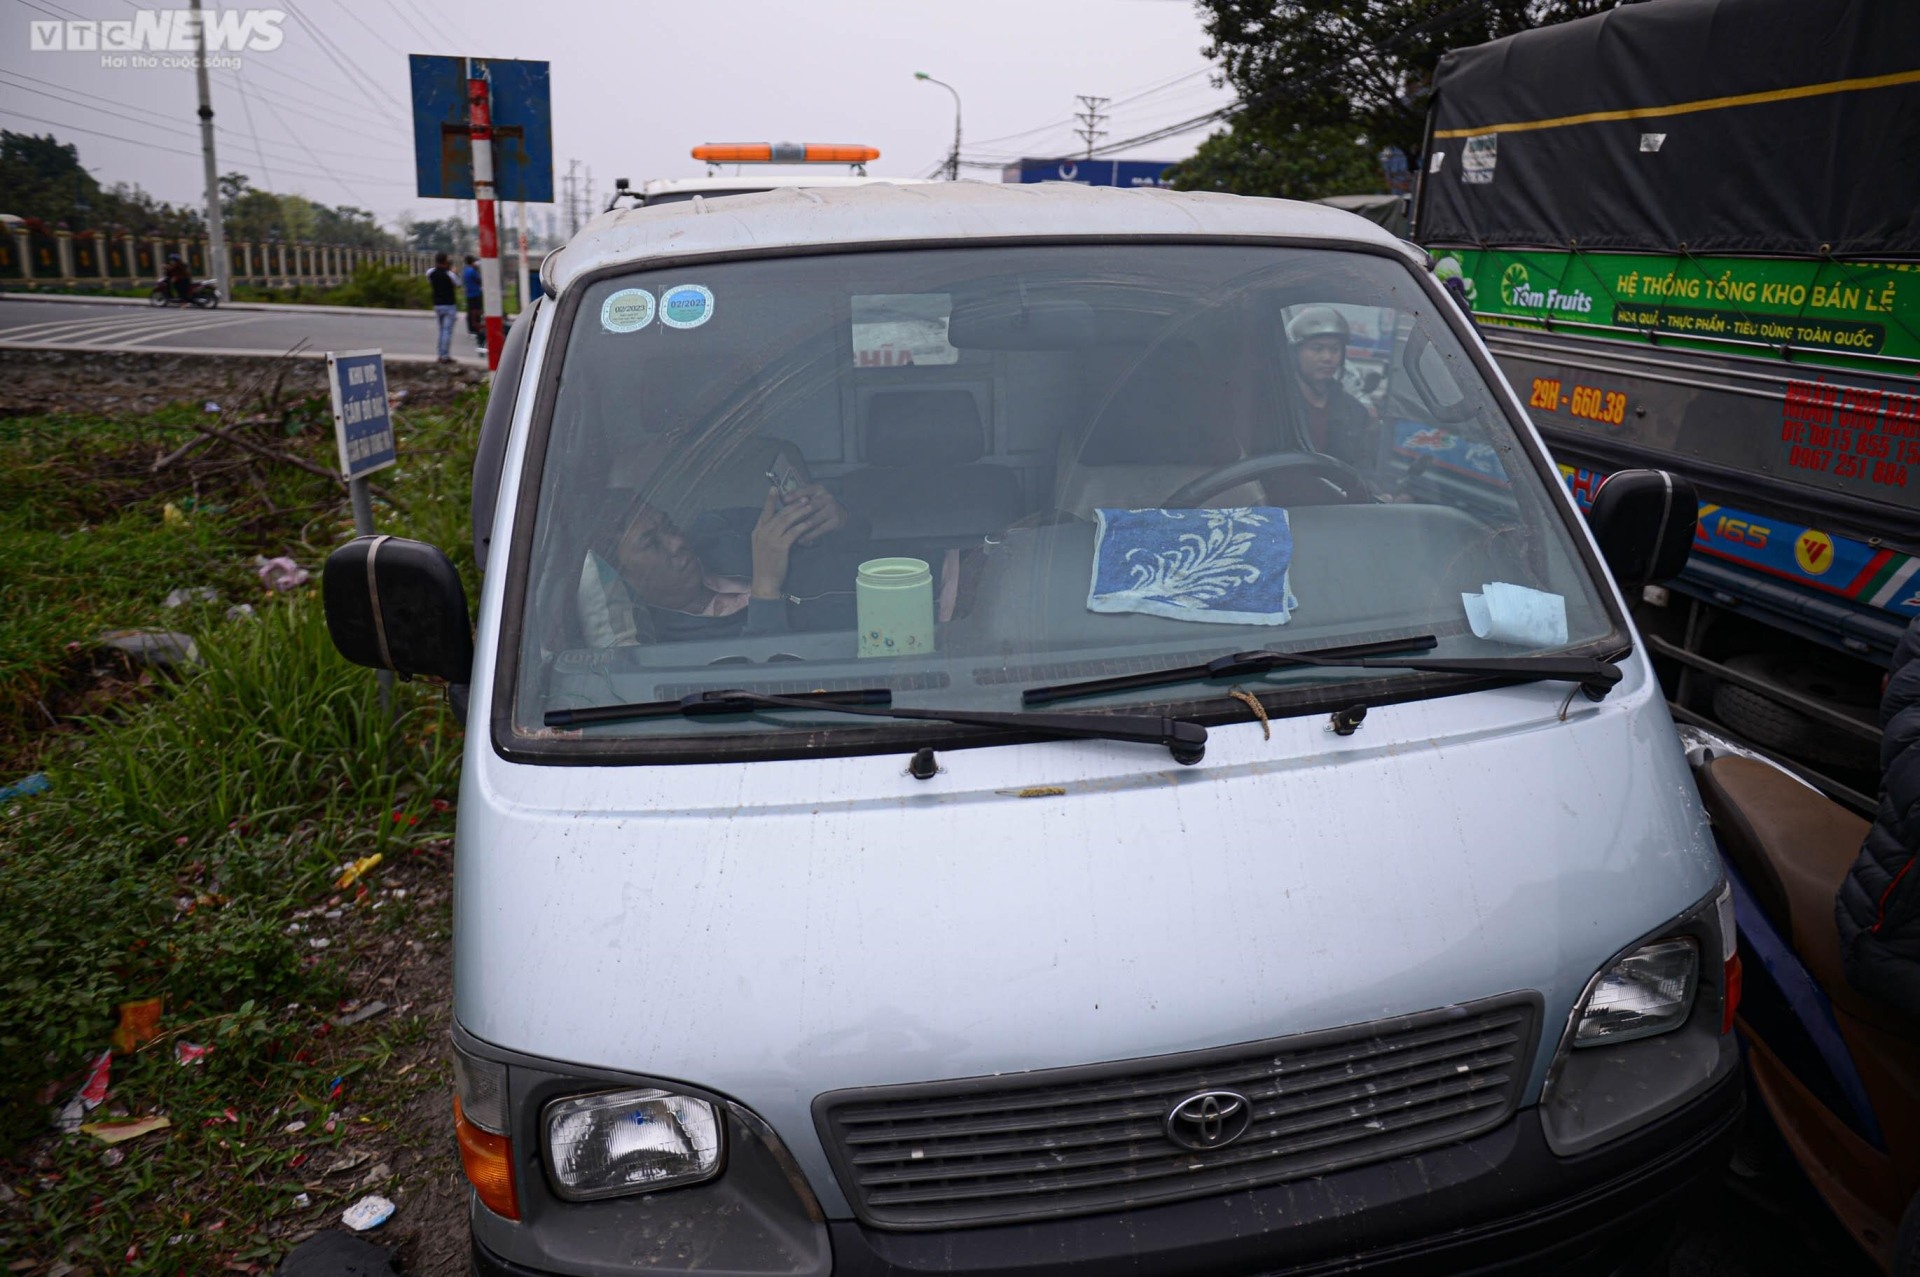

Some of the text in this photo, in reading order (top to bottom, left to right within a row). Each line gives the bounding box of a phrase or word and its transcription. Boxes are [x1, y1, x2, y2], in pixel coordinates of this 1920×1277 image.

[670, 299, 706, 309] 02/2023
[1546, 289, 1593, 313] Fruits
[1616, 270, 1896, 312] HỆ THỐNG TỔNG KHO BÁN LẺ
[614, 304, 645, 314] 02/2023
[1667, 315, 1695, 331] THỰC
[1796, 325, 1832, 344] TOÀN
[1833, 327, 1875, 348] QUỐC
[1529, 377, 1561, 413] 29H
[1570, 384, 1627, 427] 660.38
[1789, 445, 1833, 472] 0967
[1872, 460, 1907, 488] 884
